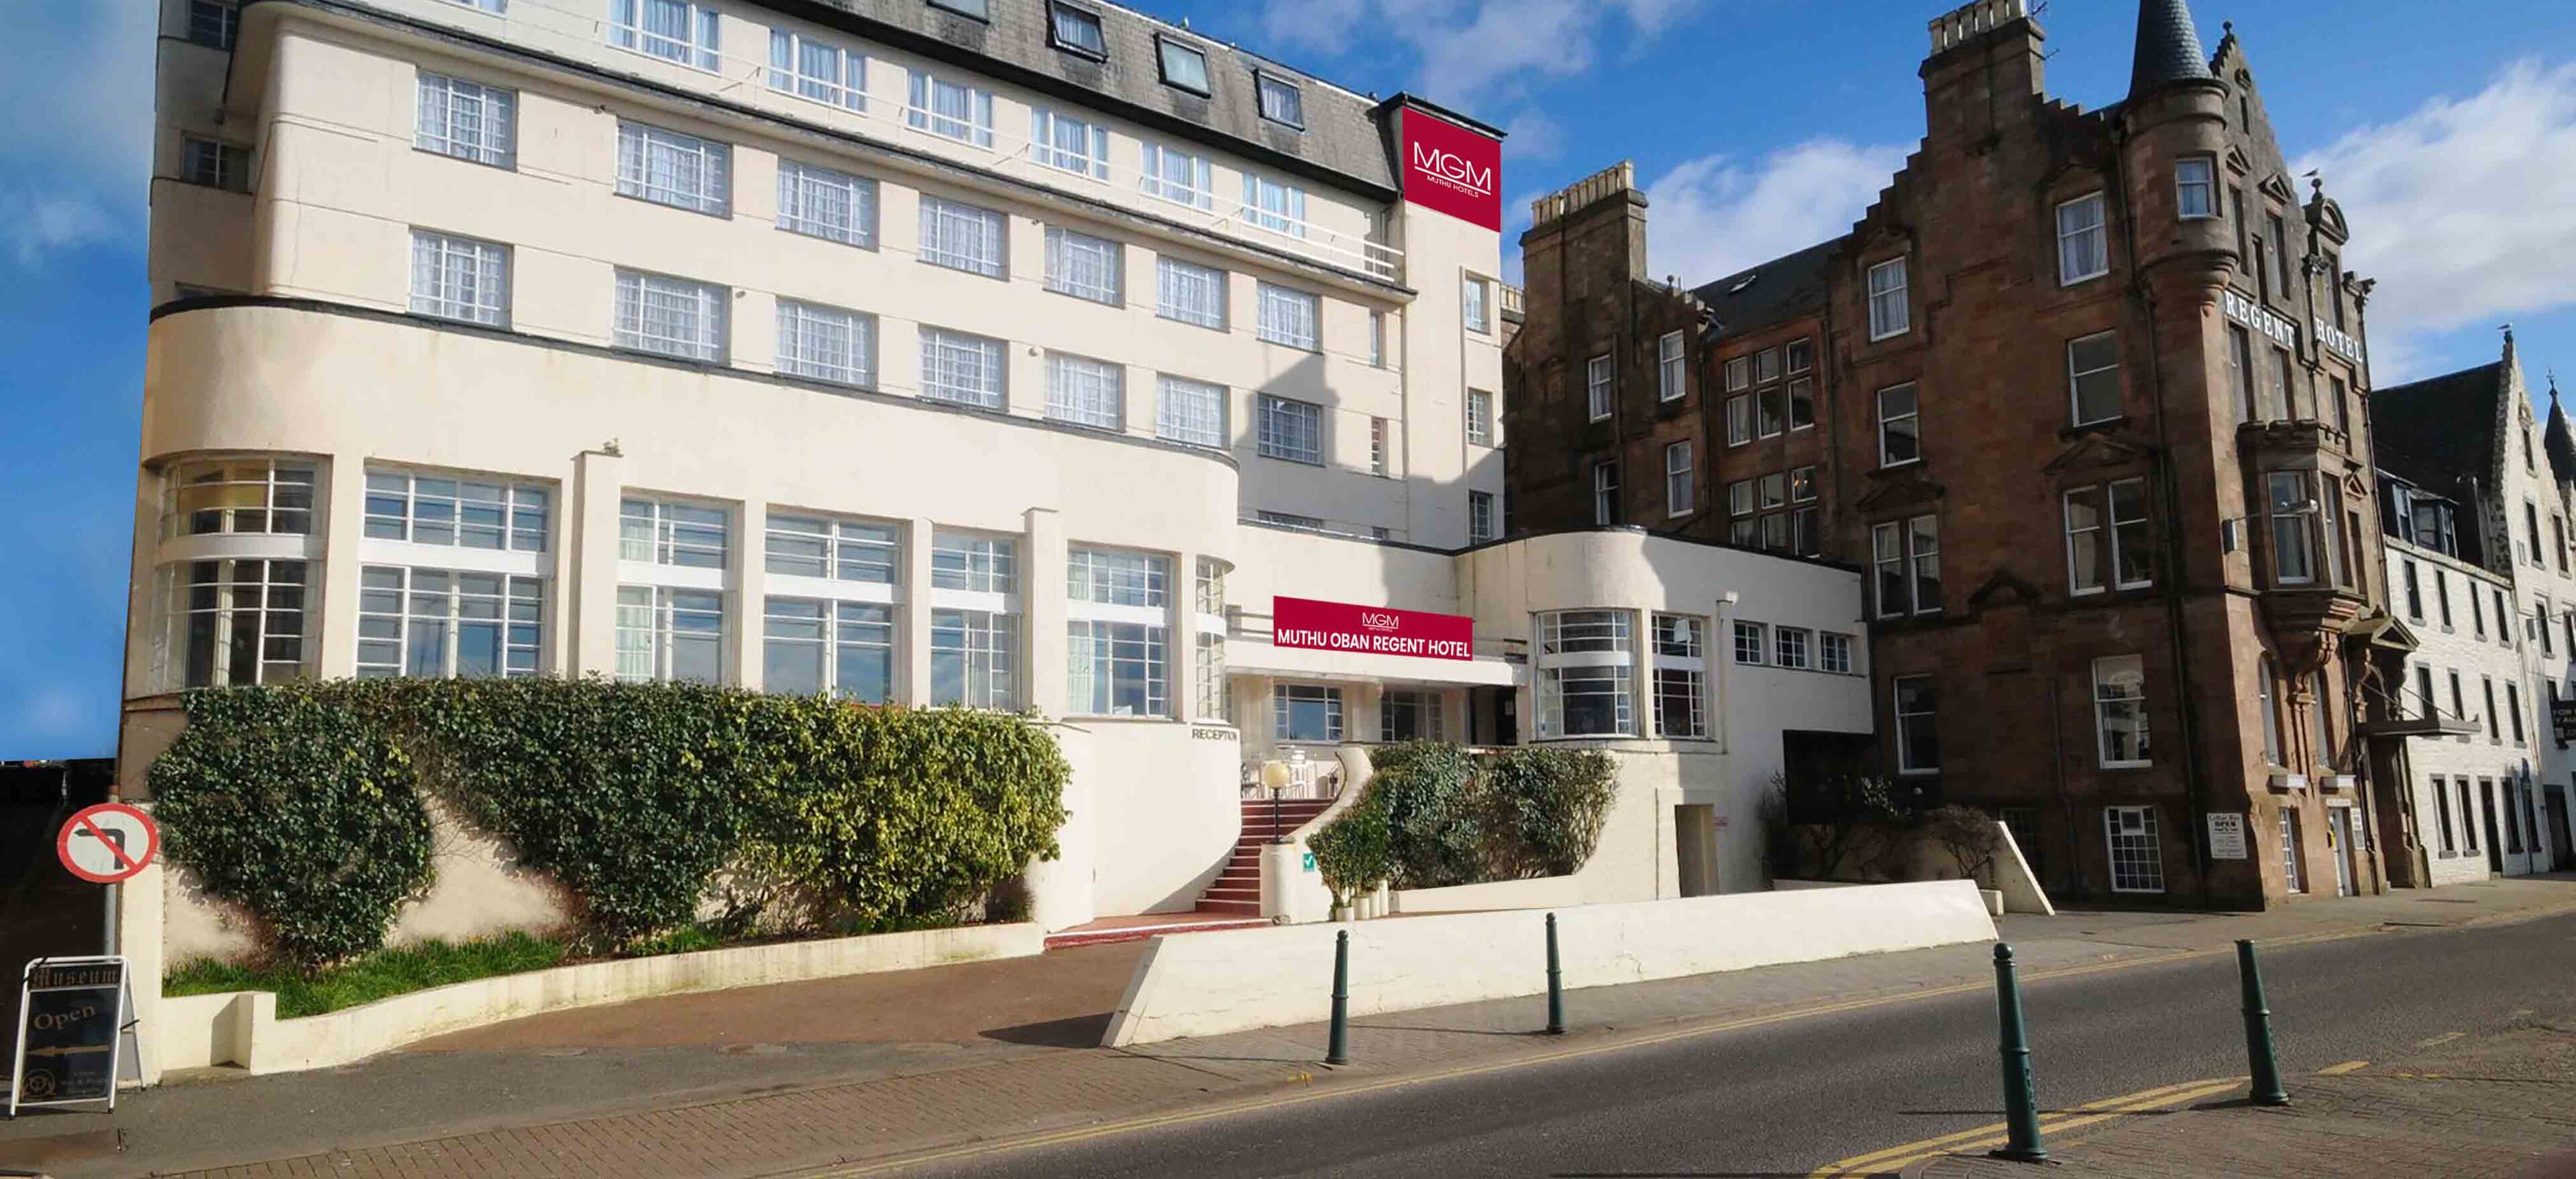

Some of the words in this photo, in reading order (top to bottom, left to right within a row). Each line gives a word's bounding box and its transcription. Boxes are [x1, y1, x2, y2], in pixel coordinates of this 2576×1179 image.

[1413, 141, 1491, 191] MGM
[1427, 175, 1452, 188] MUTHU
[1453, 184, 1479, 198] HOTELS
[2224, 290, 2295, 347] REGENT
[2314, 317, 2363, 363] HOTEL
[1362, 612, 1399, 627] MGM
[1277, 628, 1327, 647] MUTHU
[1330, 632, 1370, 650] OBAN
[1373, 635, 1426, 655] REGENT
[1428, 640, 1470, 657] HOTEL
[32, 967, 117, 987] Museum
[34, 1005, 97, 1030] Open
